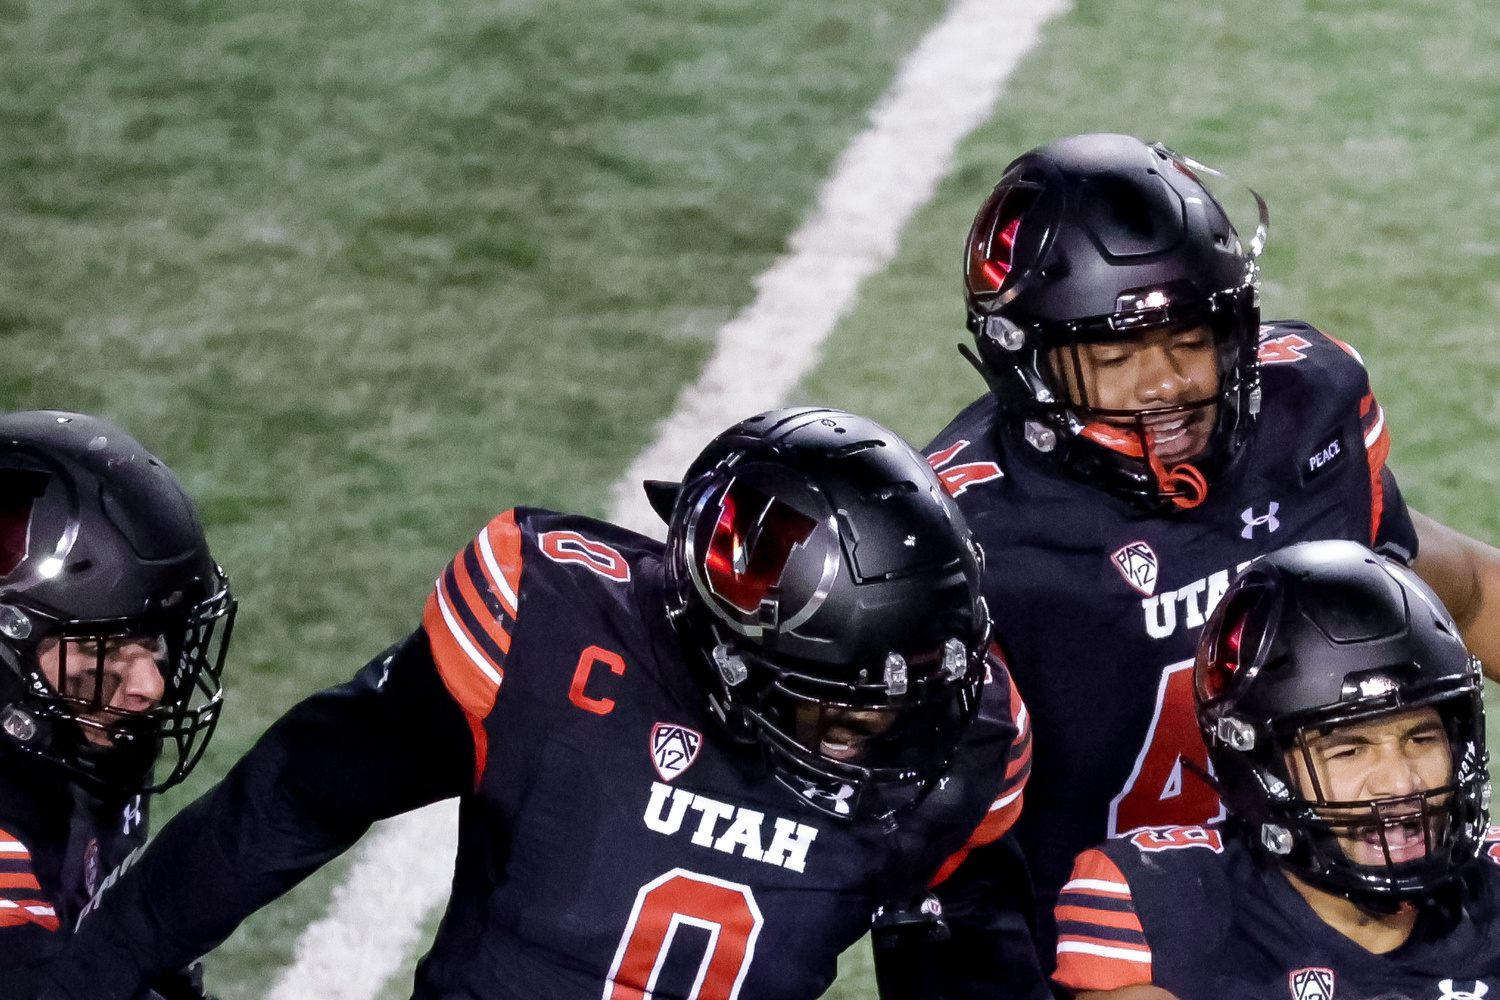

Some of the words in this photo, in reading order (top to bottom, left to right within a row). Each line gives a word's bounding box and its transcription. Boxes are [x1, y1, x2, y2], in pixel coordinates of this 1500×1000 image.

[1308, 439, 1341, 471] PEACE
[538, 531, 631, 582] 0
[1116, 543, 1156, 579] PAC
[1133, 563, 1155, 587] 12
[1141, 554, 1266, 639] UTA
[568, 645, 626, 715] C
[654, 726, 699, 763] PAC
[659, 749, 685, 771] 12
[643, 781, 818, 874] UTAH
[1116, 825, 1224, 855] 9
